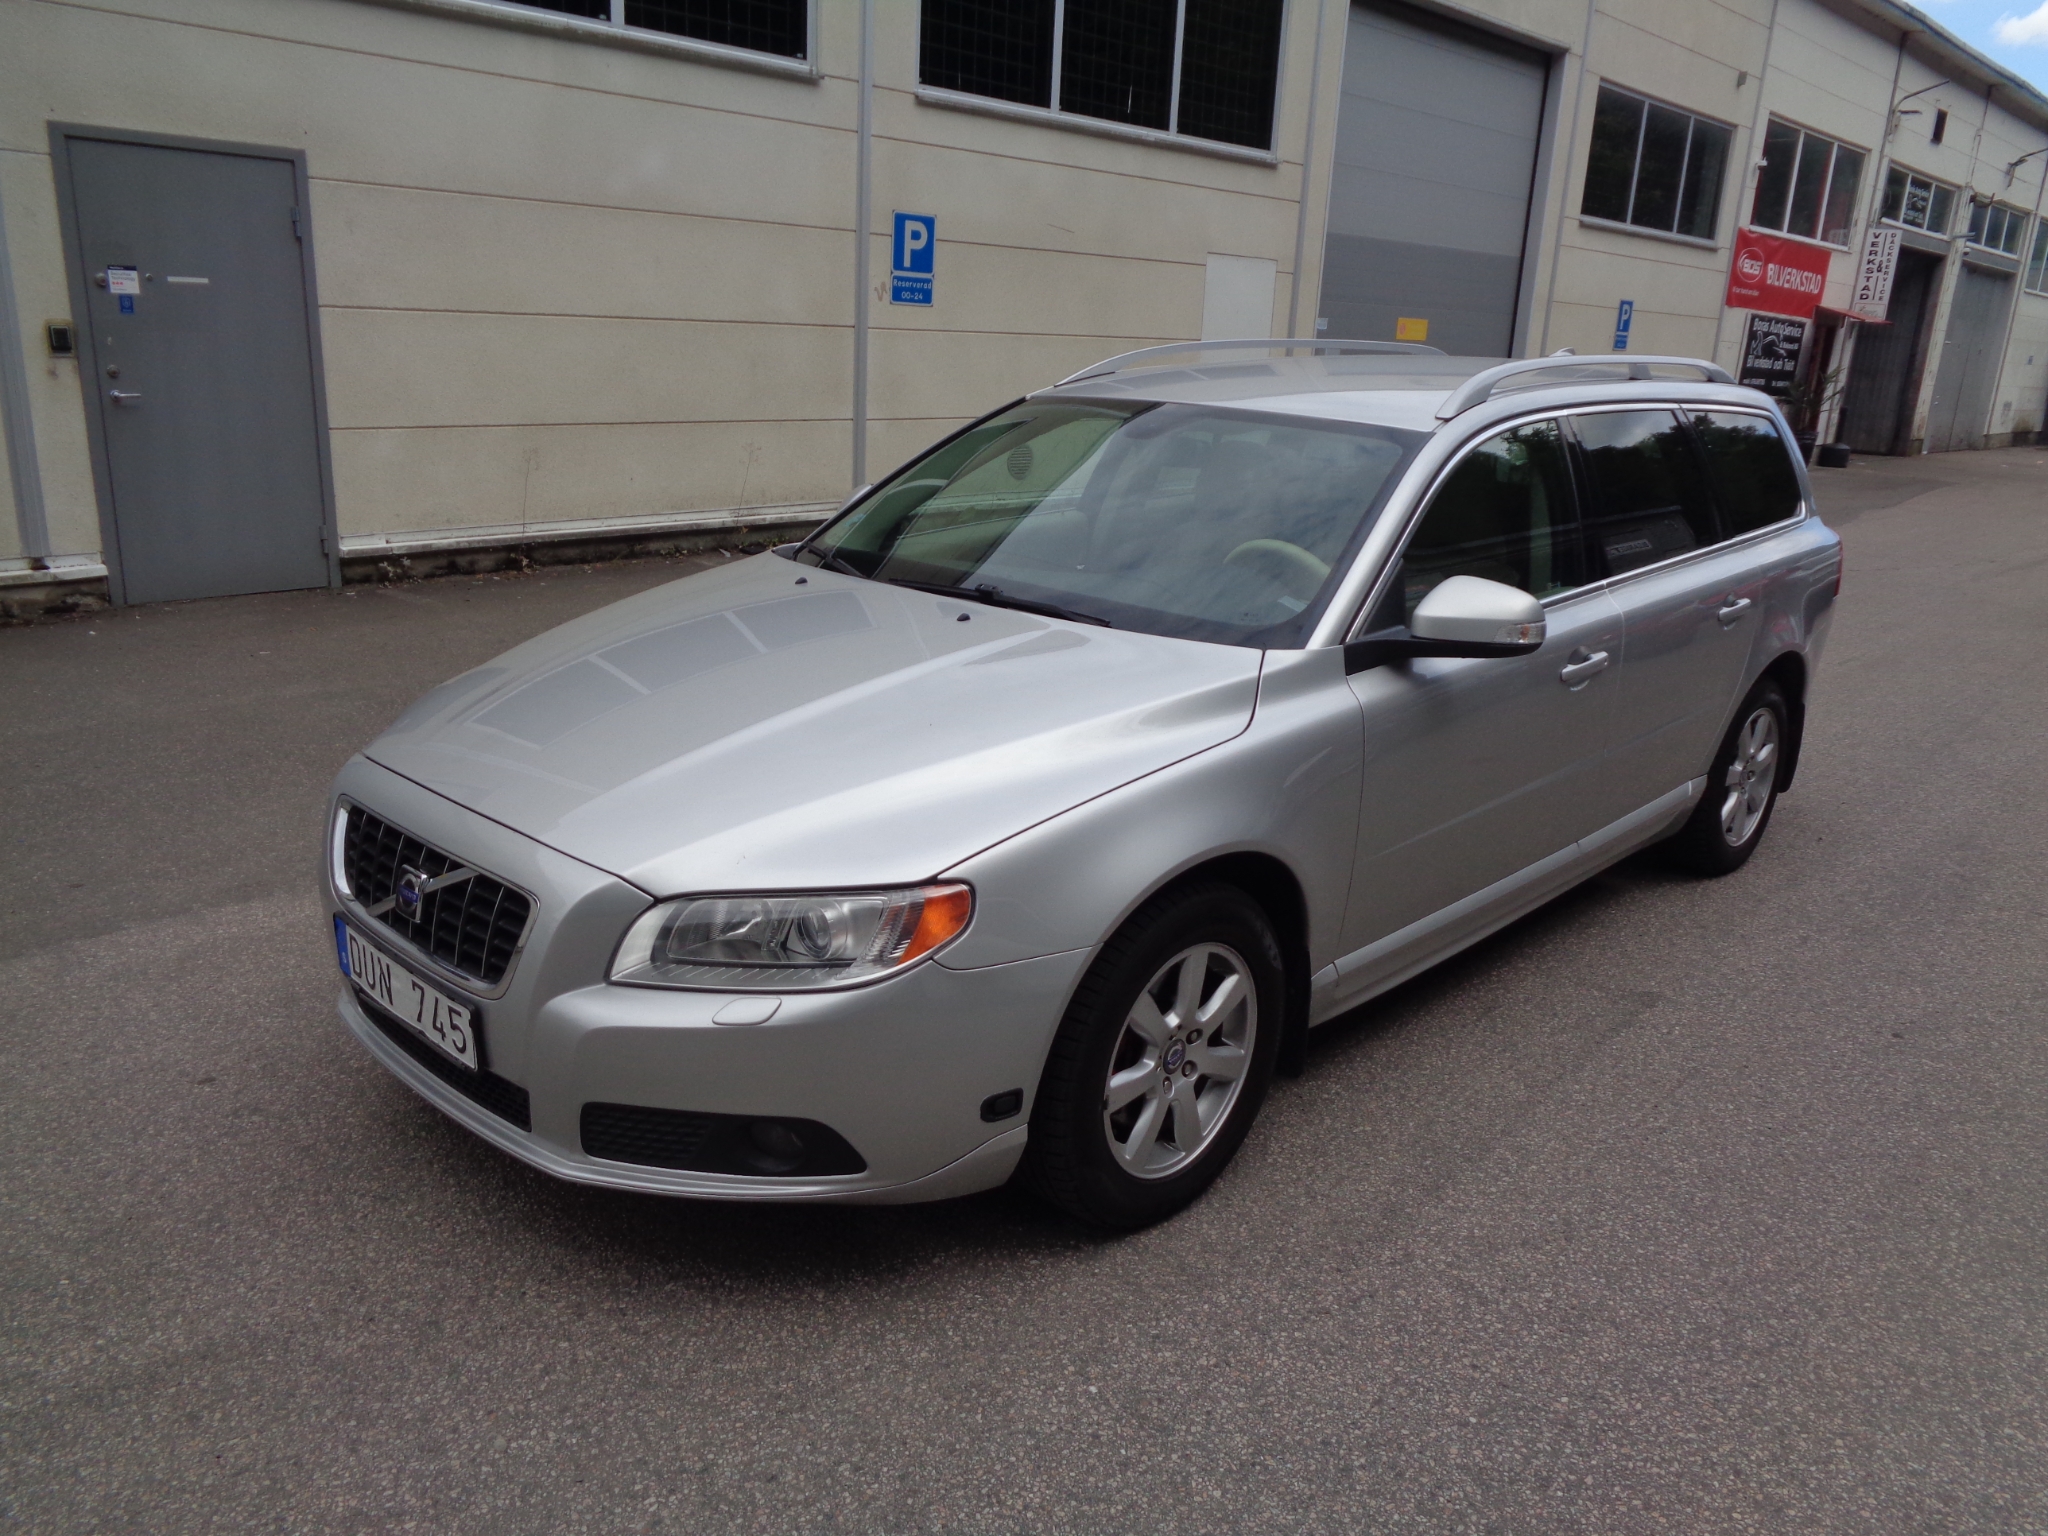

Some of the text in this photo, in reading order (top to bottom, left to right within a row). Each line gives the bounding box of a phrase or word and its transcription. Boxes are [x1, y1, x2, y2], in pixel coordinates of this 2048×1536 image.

[904, 220, 928, 268] P
[1767, 263, 1822, 294] BILVERKSTAD
[1859, 232, 1882, 300] VERKSTAD
[1876, 259, 1883, 273] &
[893, 278, 932, 290] Reserverad
[901, 291, 923, 300] 00-24
[1620, 304, 1630, 330] P
[349, 931, 467, 1054] DUN 745
